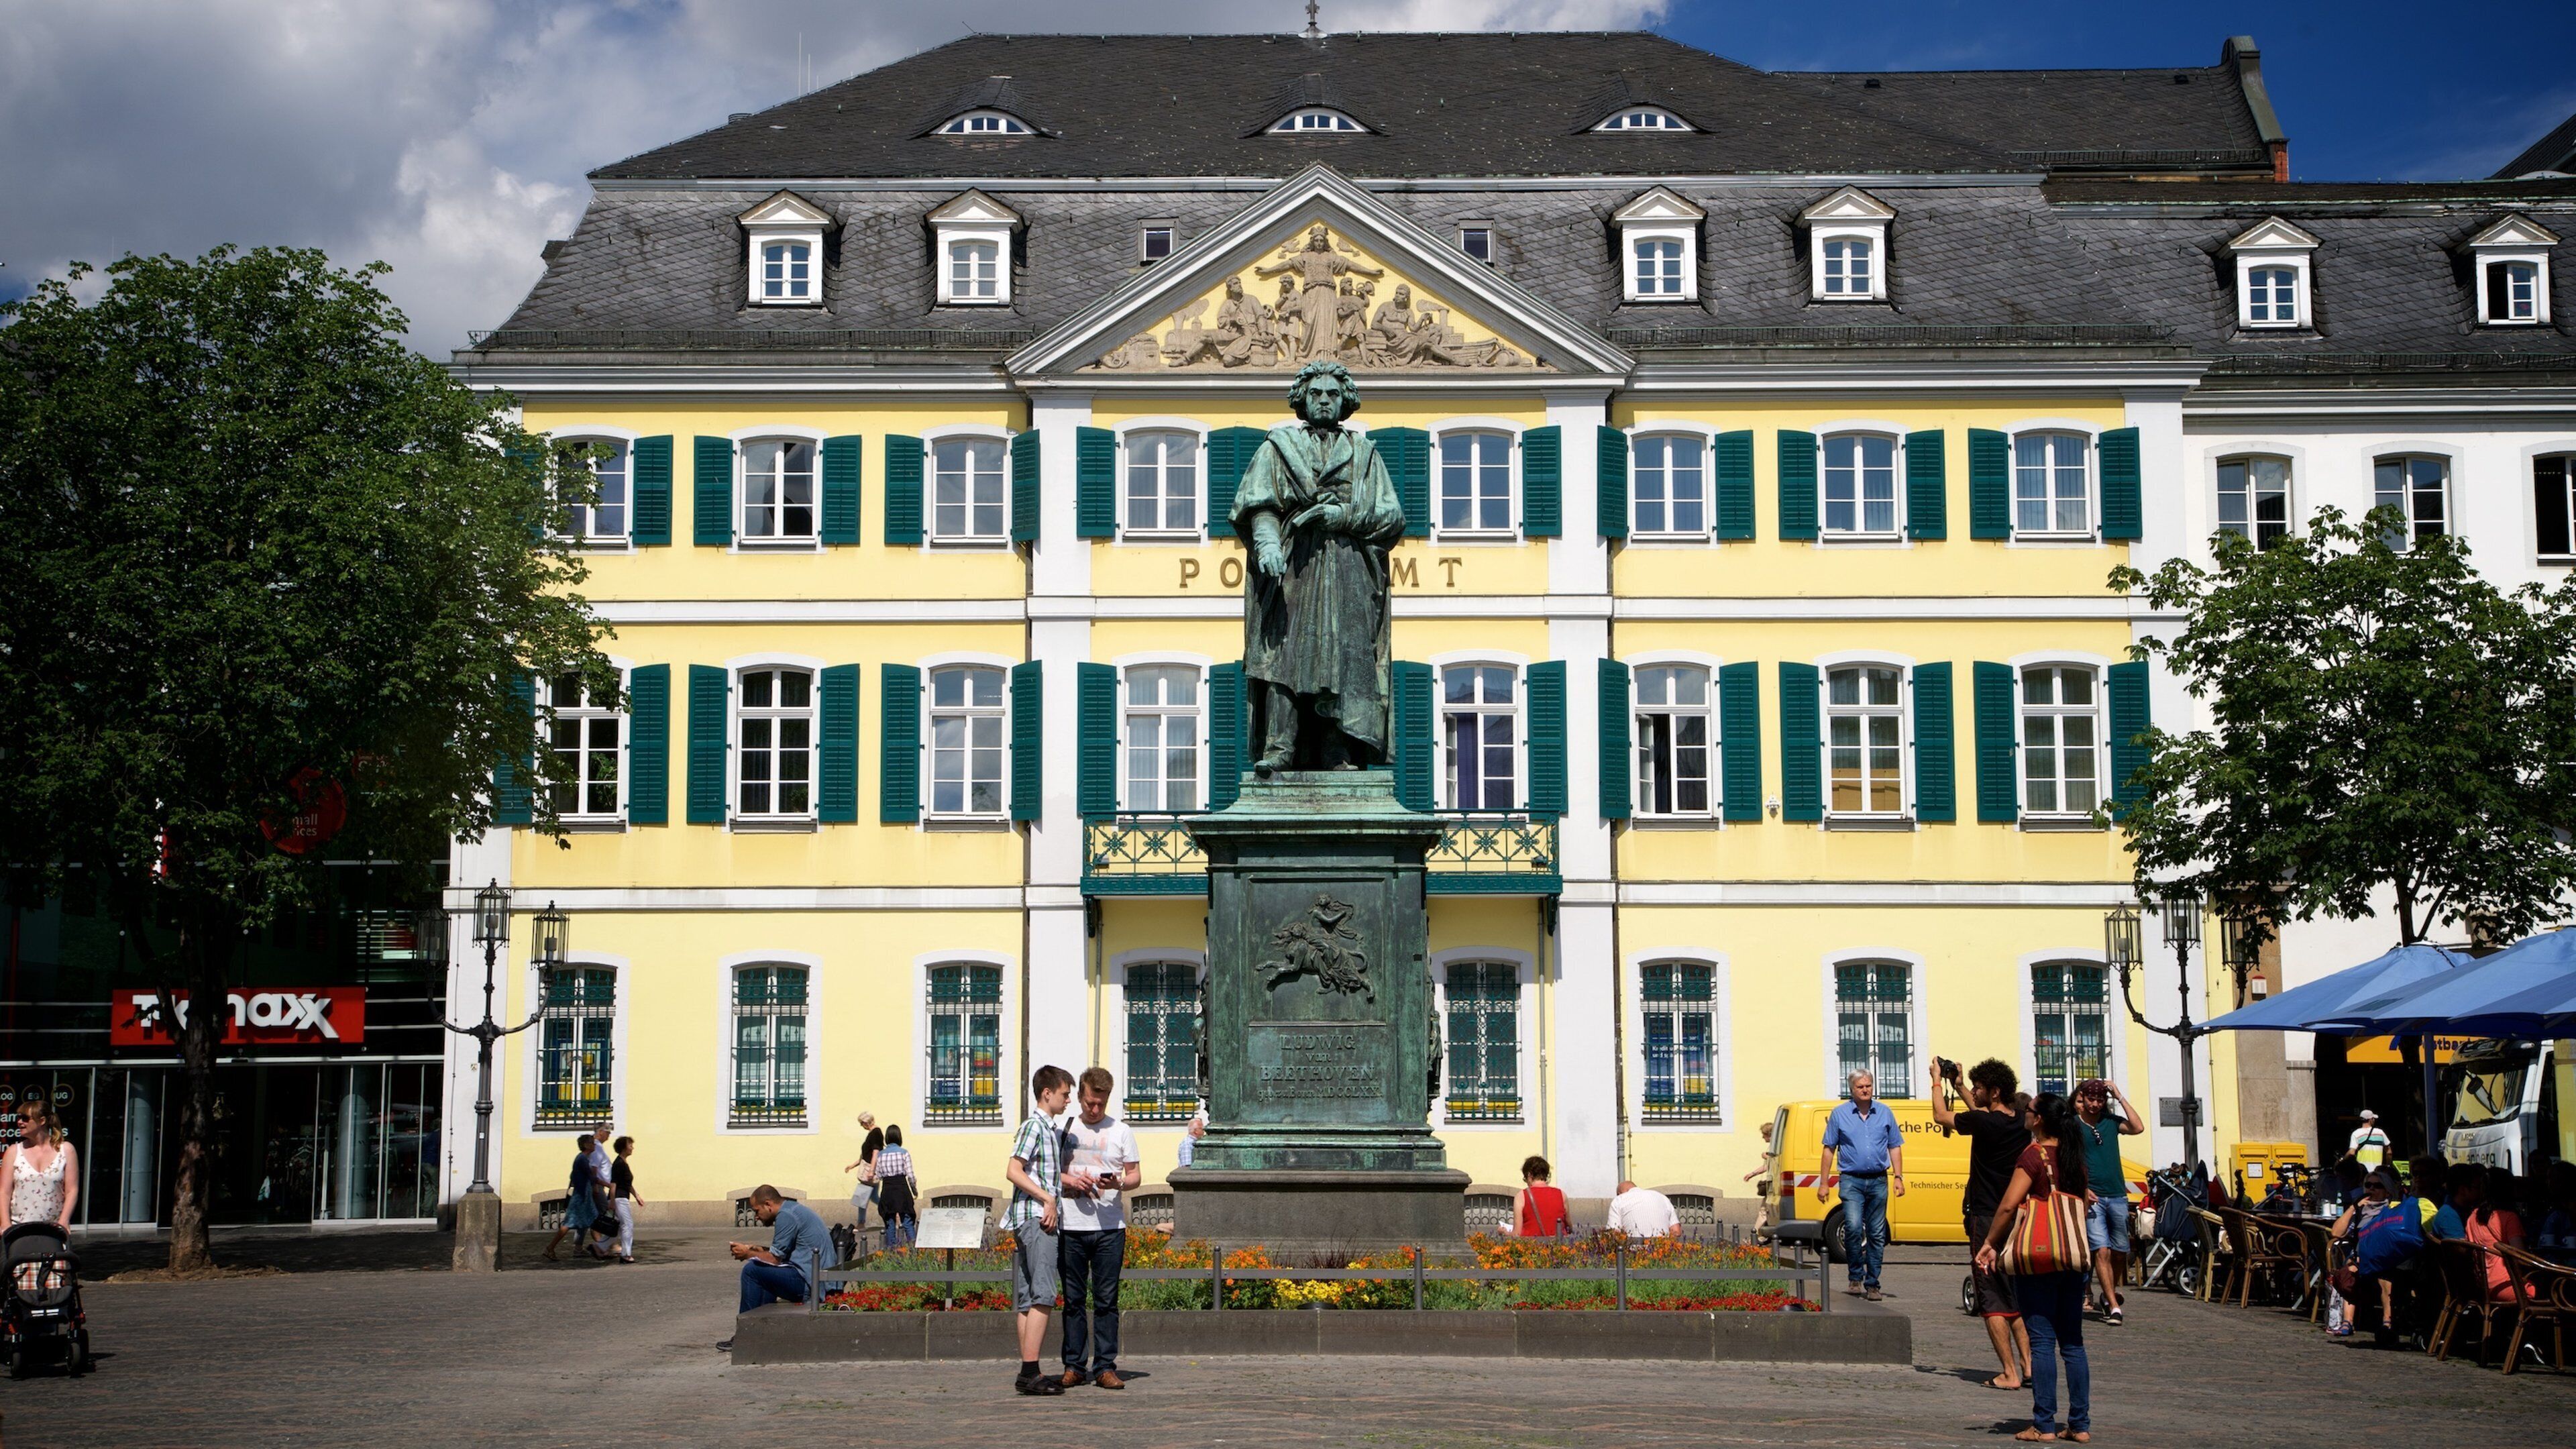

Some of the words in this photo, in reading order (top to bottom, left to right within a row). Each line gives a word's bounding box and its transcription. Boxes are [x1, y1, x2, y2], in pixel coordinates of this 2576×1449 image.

[1179, 557, 1462, 588] POMT
[292, 813, 318, 825] mall
[294, 826, 317, 837] ices
[1280, 1034, 1356, 1051] LUDWIG
[1910, 1181, 1953, 1189] Technischer
